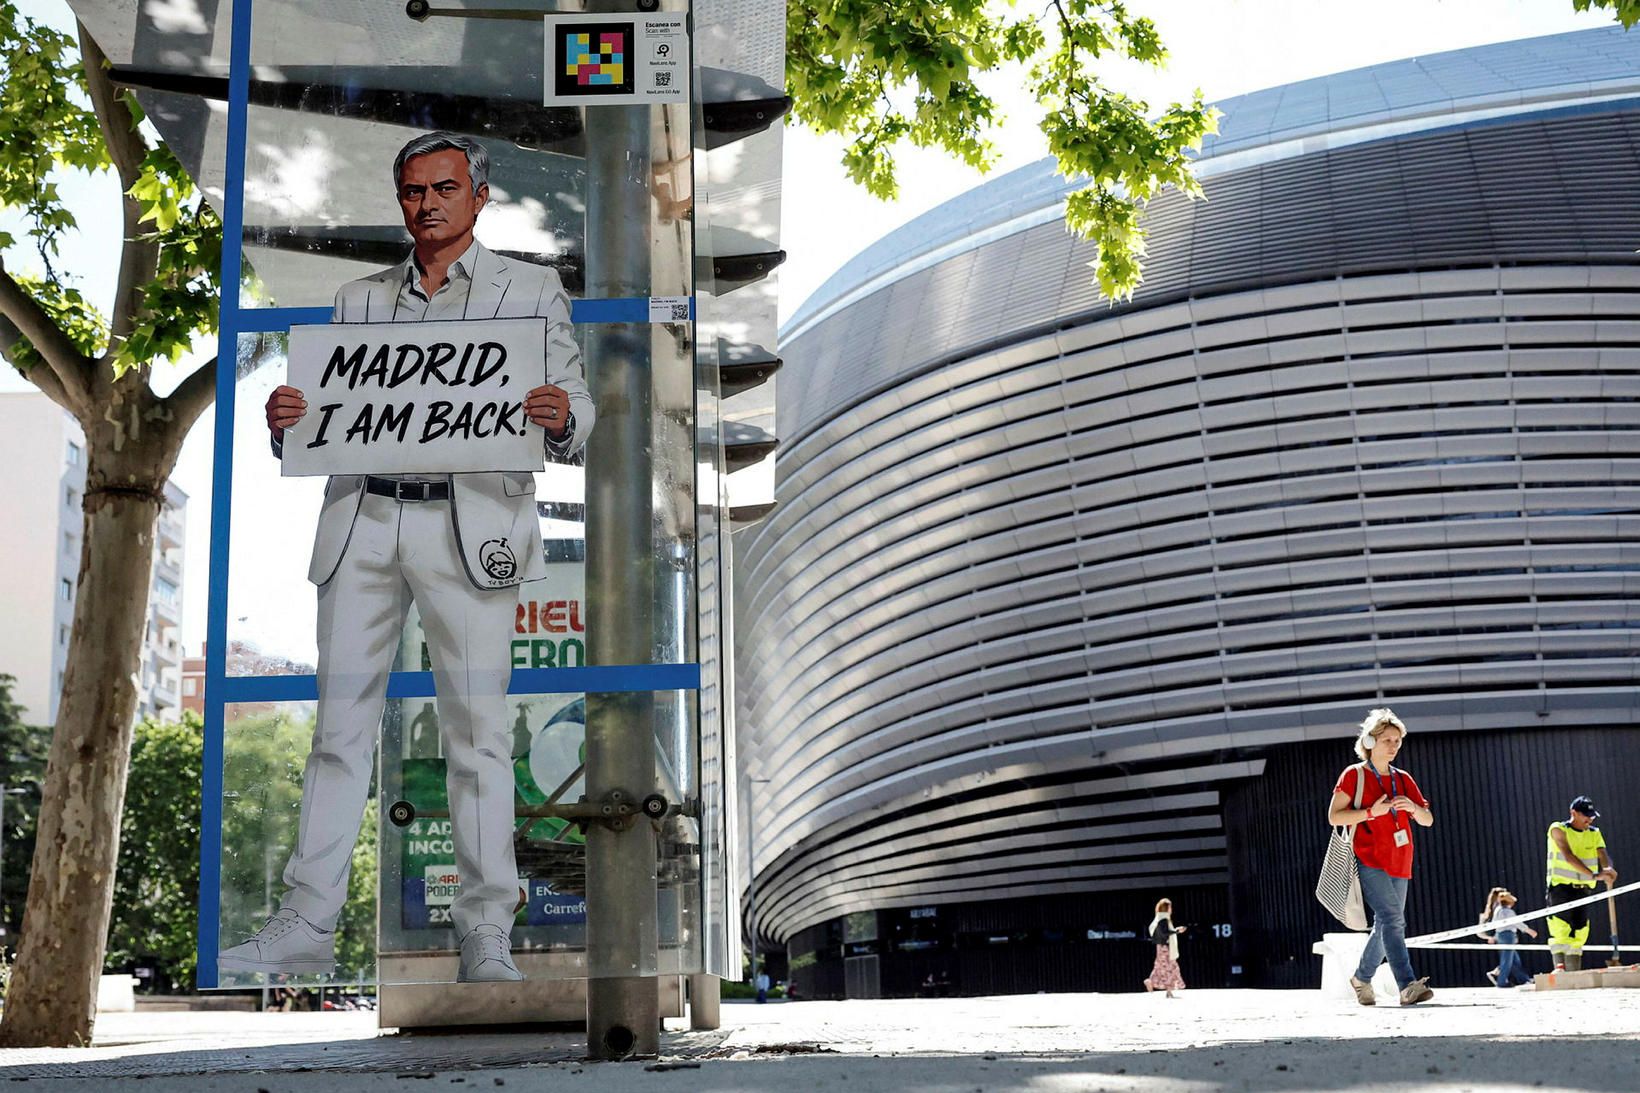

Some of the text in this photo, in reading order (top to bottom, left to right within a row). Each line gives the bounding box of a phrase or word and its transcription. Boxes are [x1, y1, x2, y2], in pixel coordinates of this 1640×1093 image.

[320, 341, 509, 391] MADRID,
[306, 401, 527, 449] I AM BACK!
[408, 822, 422, 836] 4
[408, 839, 455, 856] INCO
[1212, 924, 1232, 938] 18
